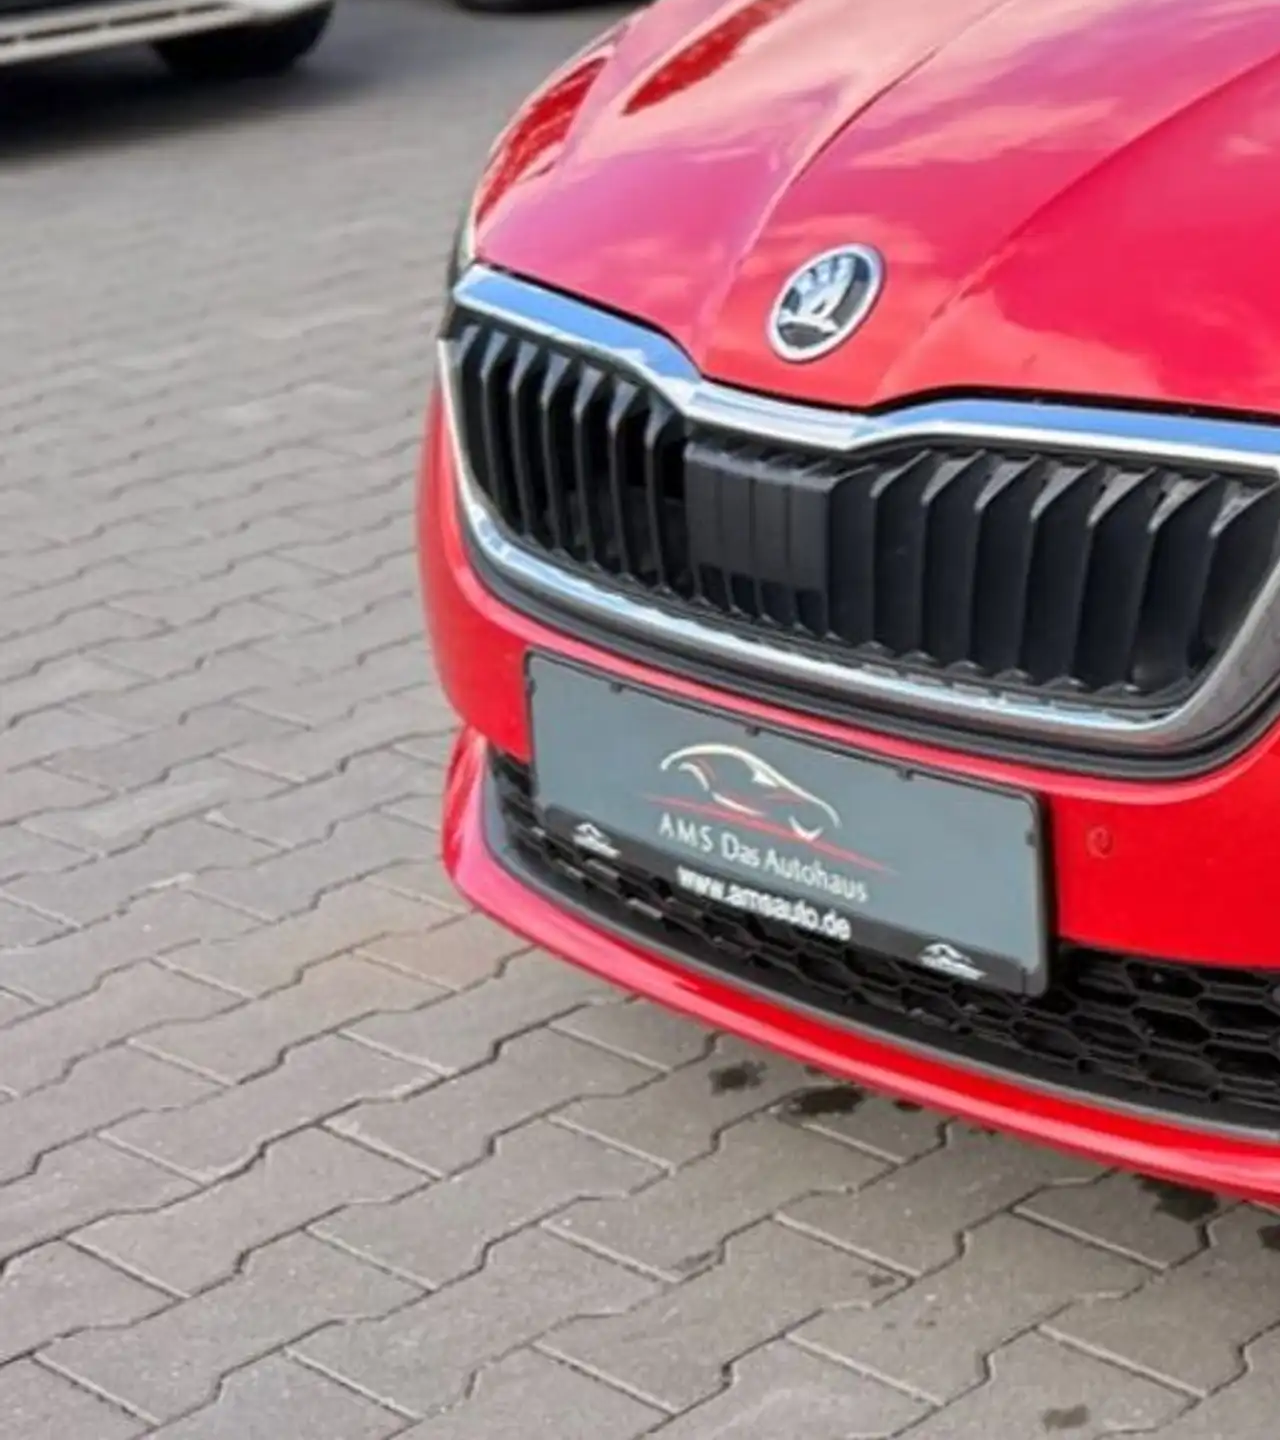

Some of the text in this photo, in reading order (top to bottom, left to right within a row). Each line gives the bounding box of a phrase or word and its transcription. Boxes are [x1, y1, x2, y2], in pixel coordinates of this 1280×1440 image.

[658, 811, 869, 903] AMS Das Autohaus
[676, 864, 852, 942] www.amsauto.de
